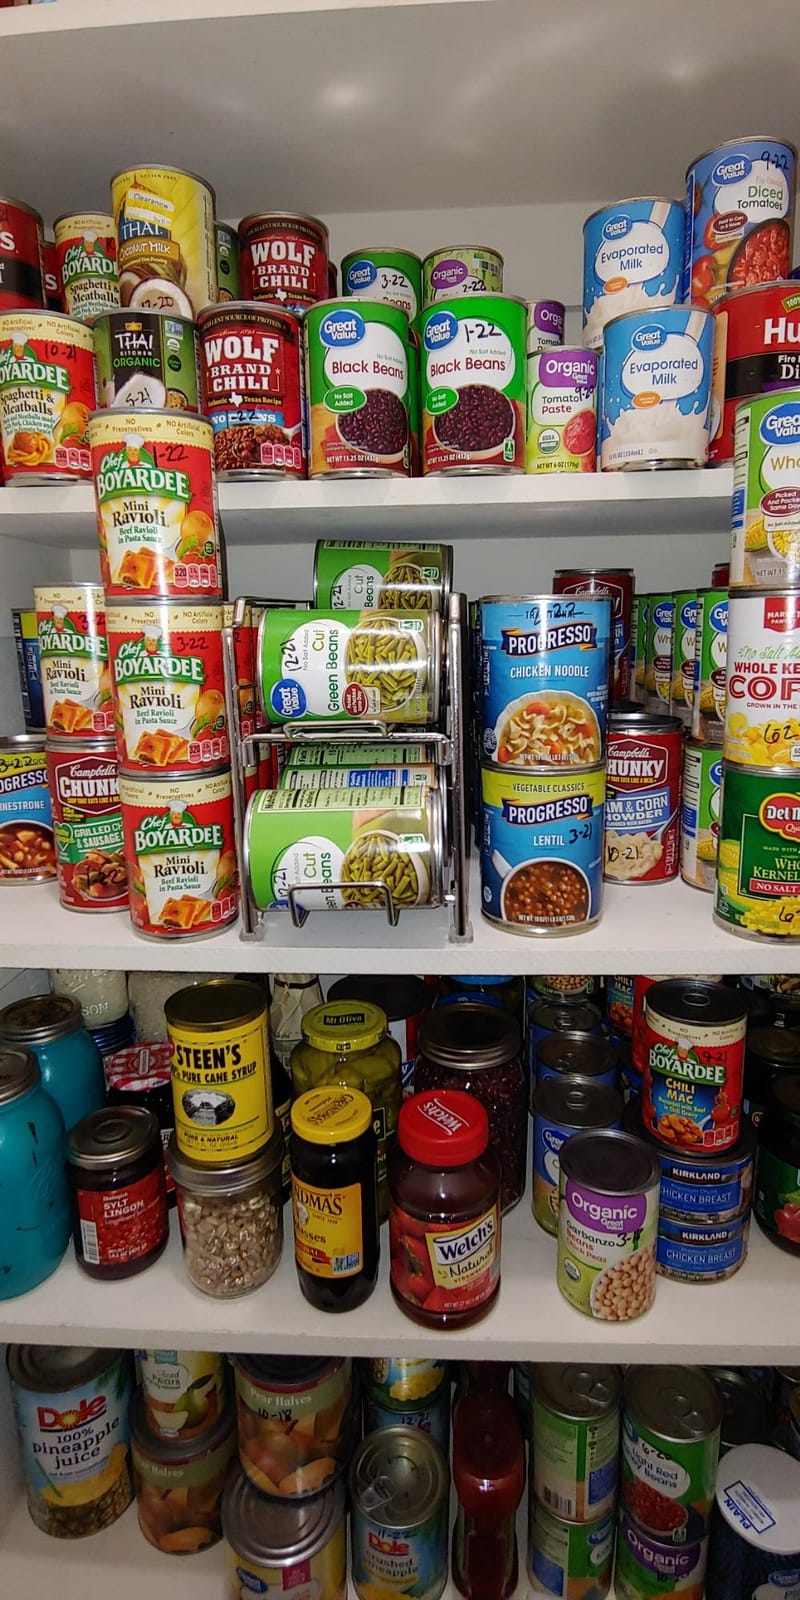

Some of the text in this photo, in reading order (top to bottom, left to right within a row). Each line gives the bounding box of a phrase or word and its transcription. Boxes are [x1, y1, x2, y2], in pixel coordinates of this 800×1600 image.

[716, 160, 745, 176] Great
[761, 151, 789, 171] 9-22
[723, 169, 744, 181] Value
[748, 186, 784, 200] Diced
[737, 199, 784, 211] Tomatoes
[121, 222, 164, 240] THAI
[605, 220, 627, 232] Great
[65, 245, 82, 261] Chef
[250, 240, 315, 268] WOLF
[601, 244, 664, 264] Evaporated
[257, 264, 310, 278] BRAND
[620, 259, 642, 271] Milk
[350, 267, 370, 280] Great
[432, 267, 464, 282] Organic
[70, 280, 111, 295] Spaghetti
[259, 276, 308, 290] CHILI
[381, 274, 408, 290] 3-22
[72, 291, 120, 305] Meatballs
[324, 320, 358, 334] Great
[332, 329, 358, 340] Value
[426, 322, 452, 338] Great
[464, 323, 502, 346] 1-22
[115, 332, 153, 350] THAI
[430, 331, 452, 344] Value
[636, 331, 661, 343] Great
[640, 337, 661, 346] Value
[45, 343, 77, 362] 10-21
[204, 336, 280, 366] WOLF
[478, 348, 488, 356] Salt
[112, 358, 160, 369] ORGANIC
[430, 356, 506, 378] Black Beans
[630, 357, 698, 375] Evaporated
[778, 355, 796, 364] Fire
[210, 363, 272, 378] BRAND
[332, 360, 404, 381] Black Beans
[546, 360, 596, 377] Organic
[212, 376, 270, 392] CHILI
[651, 372, 678, 386] Milk
[0, 388, 54, 405] Spaghetti &
[126, 390, 152, 407] 5-21
[243, 396, 282, 407] Texas Recipe
[334, 400, 354, 408] Added
[541, 395, 579, 405] Tomato
[2, 400, 54, 417] Meatballs
[542, 404, 572, 415] Paste
[112, 425, 153, 434] Preservatives
[166, 420, 200, 432] NO Artificial
[176, 428, 194, 438] Colors
[100, 452, 124, 473] Chef
[153, 445, 189, 469] 1-22
[326, 455, 335, 463] NET
[96, 468, 190, 501] BOYARDEE
[775, 491, 796, 500] Picked
[123, 501, 148, 512] Mini
[770, 503, 787, 512] Same
[112, 509, 166, 530] Ravioli
[119, 526, 159, 536] Beef Ravioli
[124, 535, 142, 544] Pasta
[175, 567, 187, 577] 320
[354, 574, 364, 594] Cut
[364, 575, 374, 609] Beans
[38, 620, 52, 636] Chef
[312, 628, 325, 652] Cut
[508, 625, 591, 655] PROGRESSO
[118, 642, 142, 658] Chef
[759, 644, 780, 660] Salt
[52, 660, 72, 670] Mini
[114, 657, 204, 682] BOYARDEE
[326, 629, 338, 711] Green Beans
[510, 664, 590, 679] CHICKEN NOODLE
[734, 662, 778, 675] WHOLE
[46, 668, 86, 684] Ravioli
[140, 686, 166, 696] Mini
[130, 695, 182, 711] Ravioli
[281, 687, 292, 716] Great
[136, 710, 174, 718] Beef Ravioli
[158, 717, 178, 726] Sauce
[70, 764, 118, 780] Campbell's
[512, 783, 585, 794] VEGETABLE CLASSICS
[509, 796, 588, 825] PROGRESSO
[626, 800, 634, 812] &
[636, 794, 668, 812] CORN
[766, 806, 789, 820] Del
[74, 826, 111, 838] GRILLED
[141, 817, 166, 832] Chef
[82, 834, 120, 848] SAUSAGE
[134, 825, 223, 854] BOYARDEE
[533, 835, 565, 846] LENTIL
[568, 822, 592, 846] 3-21
[166, 856, 190, 865] Mini
[304, 853, 316, 878] Cut
[154, 862, 207, 879] Ravioli
[161, 876, 199, 886] Beef Ravioli
[166, 882, 201, 892] Pasta Sauce
[756, 882, 797, 894] NO SALT
[615, 983, 632, 998] MAC
[176, 1044, 240, 1070] STEEN'S
[654, 1043, 674, 1058] Chef
[182, 1062, 257, 1084] PURE CANE SYRUP
[649, 1050, 725, 1084] BOYARDEE
[665, 1078, 696, 1094] CHILI
[666, 1090, 693, 1106] MAC
[424, 1101, 463, 1133] Welch's
[184, 1132, 238, 1143] PURE NATURAL
[673, 1167, 721, 1180] KIRKLAND
[104, 1198, 128, 1210] SYLT
[572, 1191, 638, 1220] Organic
[698, 1194, 732, 1204] BREAST
[104, 1200, 144, 1219] LINGON
[438, 1219, 494, 1262] Welch's
[566, 1219, 616, 1248] Garbanzo
[566, 1228, 594, 1252] Beans
[682, 1230, 728, 1242] KIRKLAND
[449, 1245, 495, 1280] Natural
[666, 1249, 736, 1265] CHICKEN BREAST
[275, 1394, 312, 1408] Halves
[37, 1395, 107, 1431] Dole
[58, 1426, 94, 1444] 100%
[55, 1446, 100, 1470] juice
[656, 1464, 678, 1481] Red
[725, 1498, 752, 1530] PLAIN
[368, 1532, 410, 1556] Dole
[628, 1529, 689, 1567] Organic
